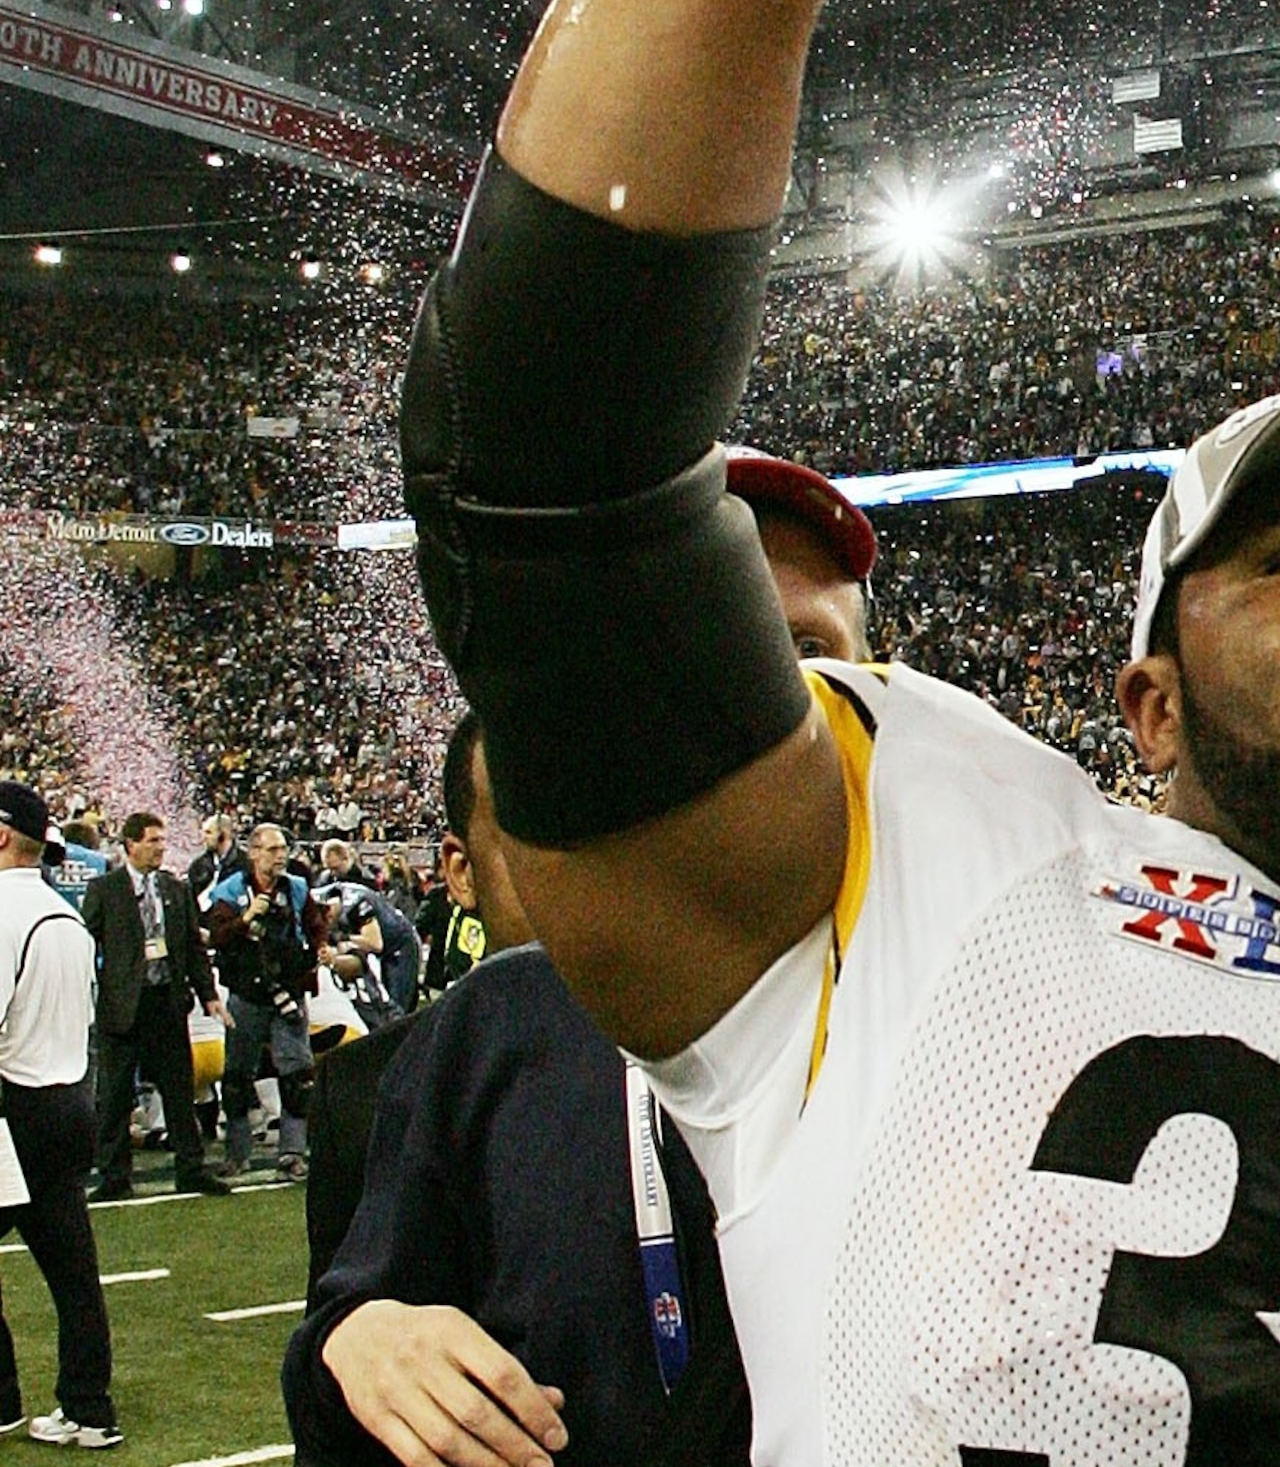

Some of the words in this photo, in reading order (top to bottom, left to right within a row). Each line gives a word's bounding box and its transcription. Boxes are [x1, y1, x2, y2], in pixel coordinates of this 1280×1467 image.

[74, 44, 277, 128] ANNIVERSARY
[104, 522, 156, 542] Detroit
[211, 522, 274, 548] Dealers
